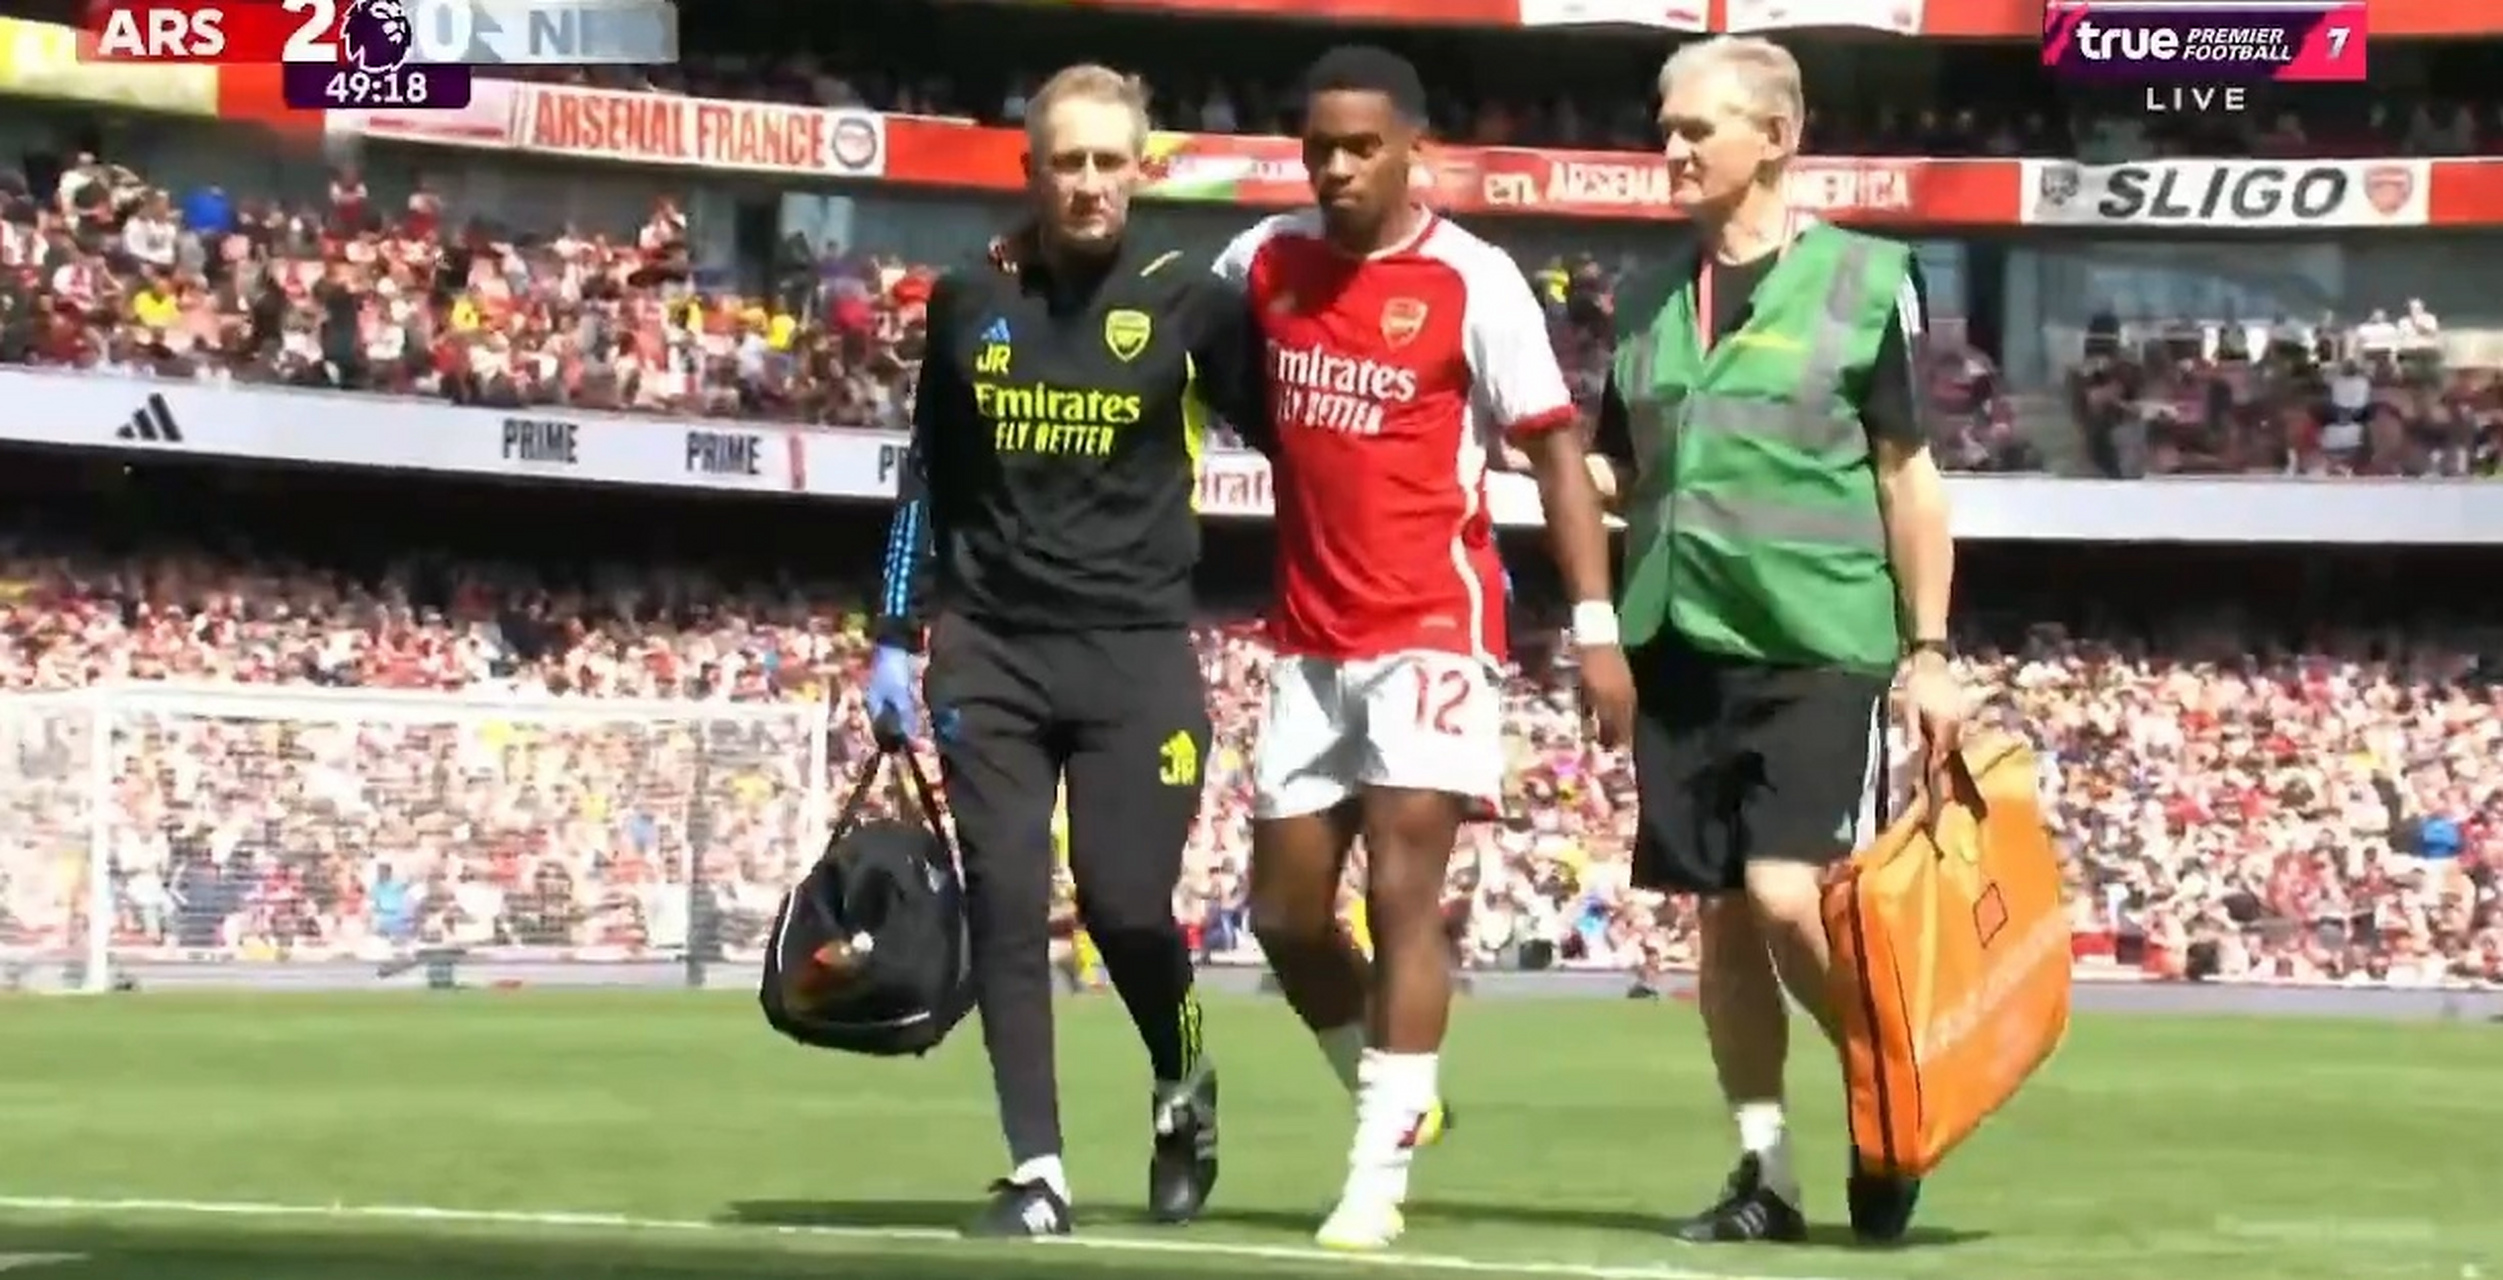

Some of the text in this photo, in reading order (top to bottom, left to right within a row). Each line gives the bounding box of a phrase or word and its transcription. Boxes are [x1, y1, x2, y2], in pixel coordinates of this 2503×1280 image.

[533, 91, 687, 157] ARSENAL
[699, 100, 826, 168] FRANCE
[1548, 161, 1672, 206] ARSENA
[2098, 166, 2348, 220] SLIGO
[975, 342, 1011, 374] JR
[1270, 341, 1417, 402] mirates
[973, 382, 1141, 424] Emirates
[502, 417, 579, 465] PRIME
[685, 430, 763, 476] PRIME
[995, 421, 1115, 456] FLY BETTER
[1414, 664, 1471, 735] 12
